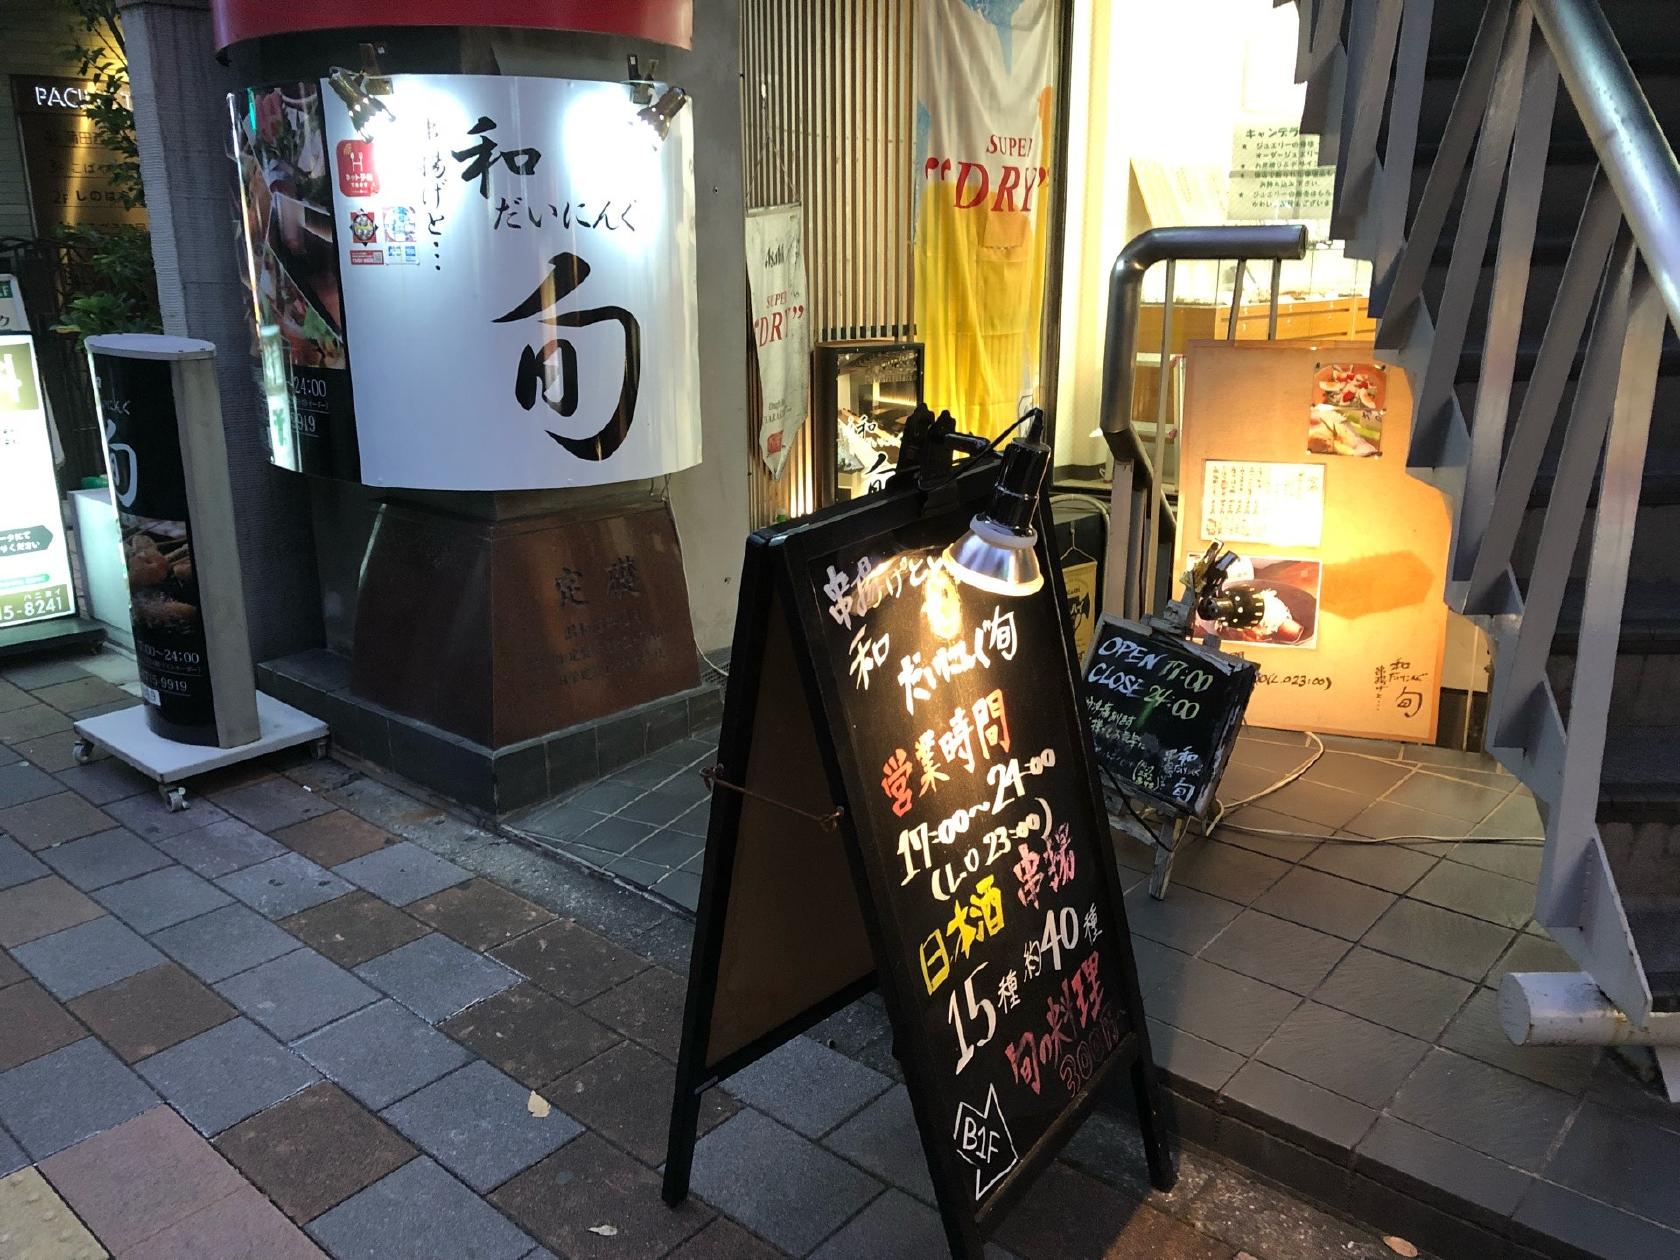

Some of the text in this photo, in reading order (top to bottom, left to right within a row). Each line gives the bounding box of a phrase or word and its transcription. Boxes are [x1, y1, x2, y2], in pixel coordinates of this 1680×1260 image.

[451, 116, 542, 199] 和
[491, 251, 641, 463] 旬
[1098, 636, 1168, 671] OPEN
[1087, 662, 1146, 699] CLOSE
[1143, 684, 1201, 720] 24:00
[1396, 686, 1423, 718] 旬
[880, 688, 1011, 818] 営業時間
[919, 874, 1005, 996] 日本酒
[962, 1115, 1001, 1165] B1F
